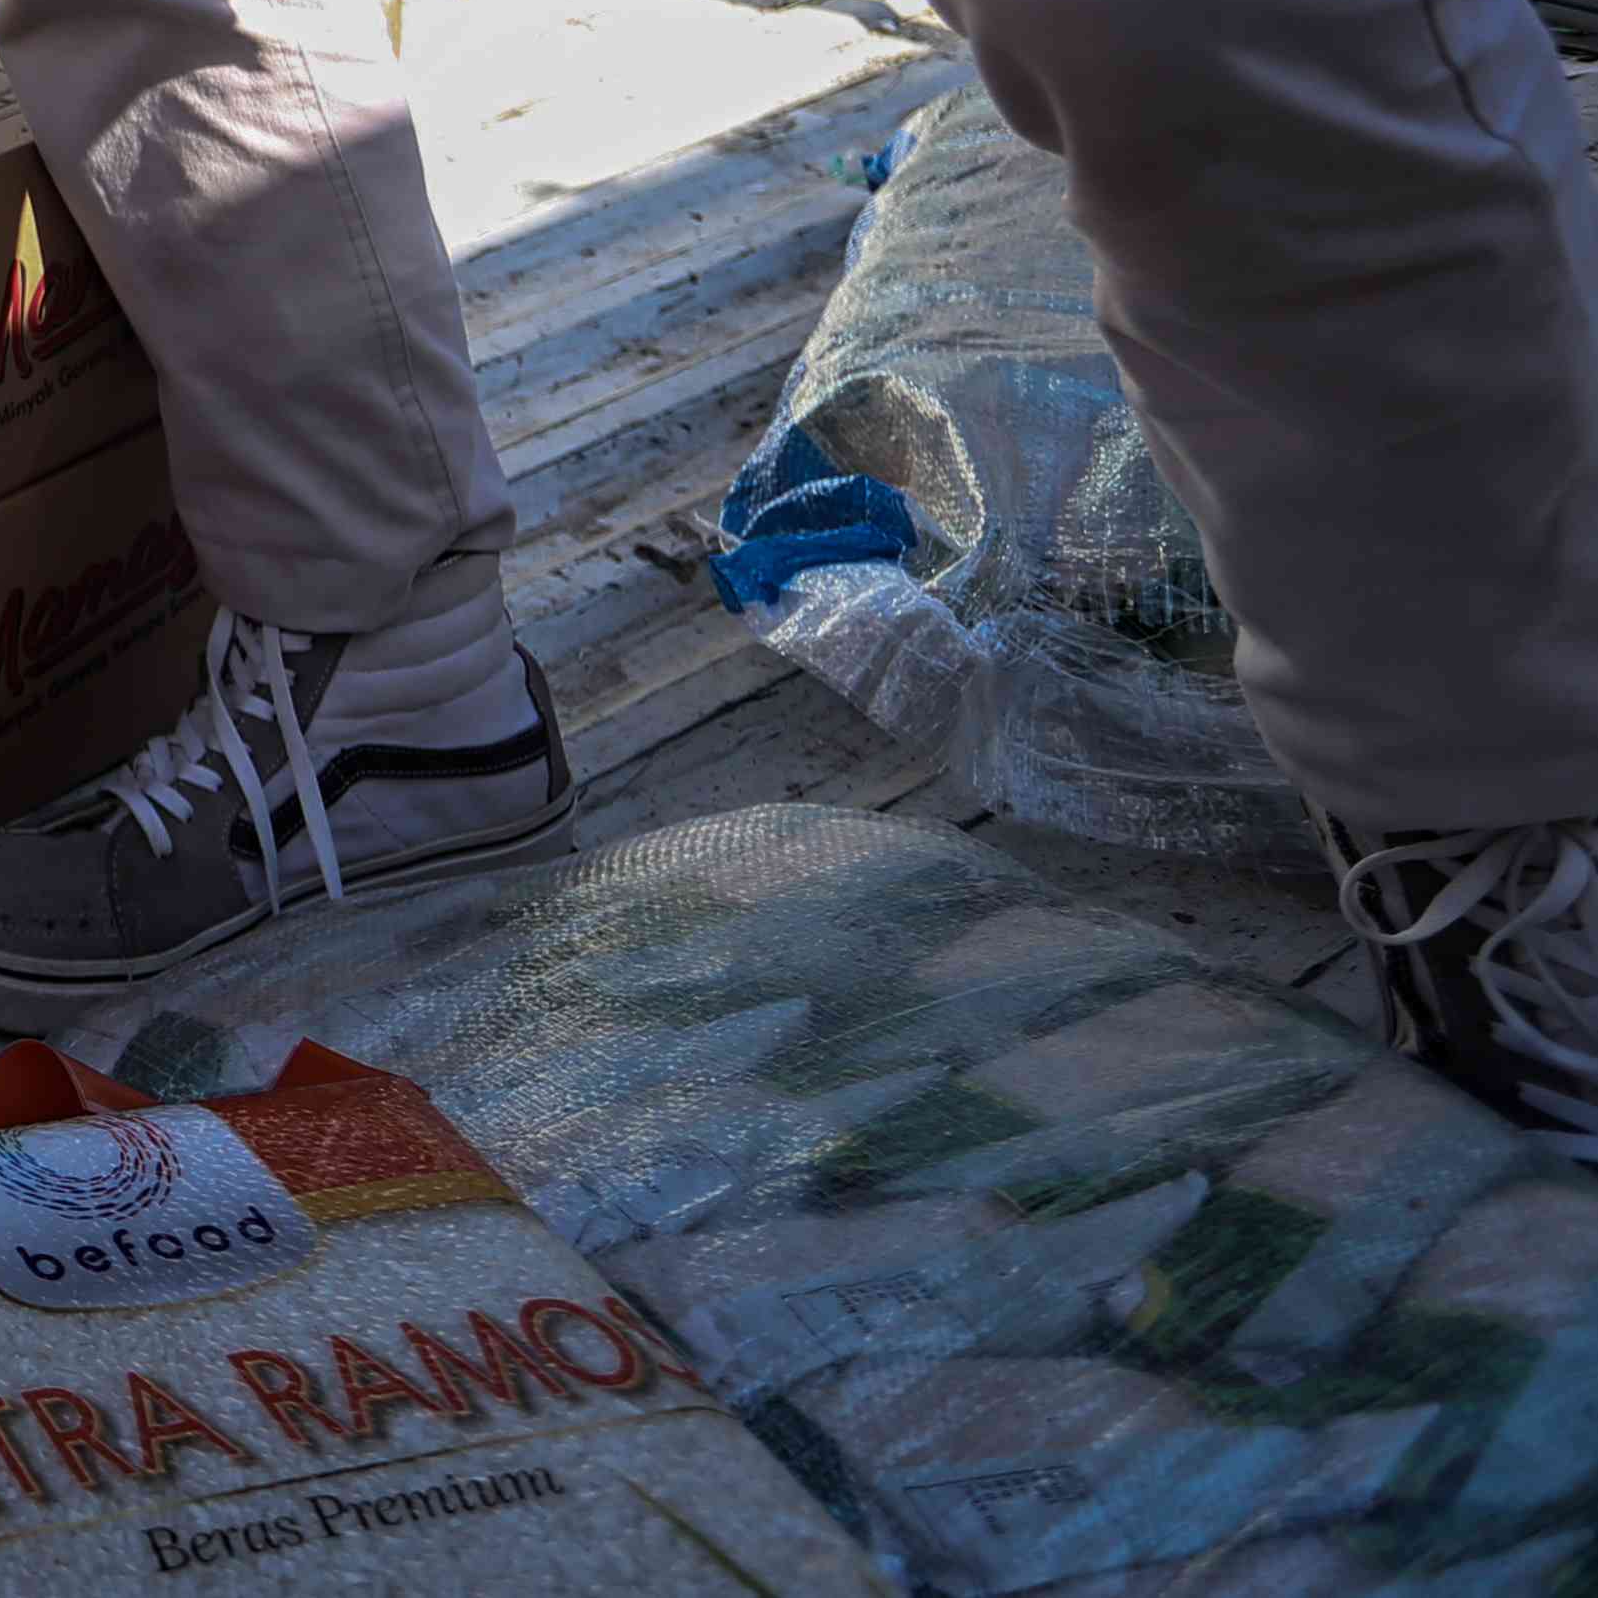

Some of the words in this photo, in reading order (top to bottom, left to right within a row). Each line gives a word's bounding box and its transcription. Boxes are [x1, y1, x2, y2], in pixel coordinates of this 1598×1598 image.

[14, 1204, 278, 1283] befood
[140, 1508, 307, 1575] Beras
[307, 1462, 567, 1542] Premium
